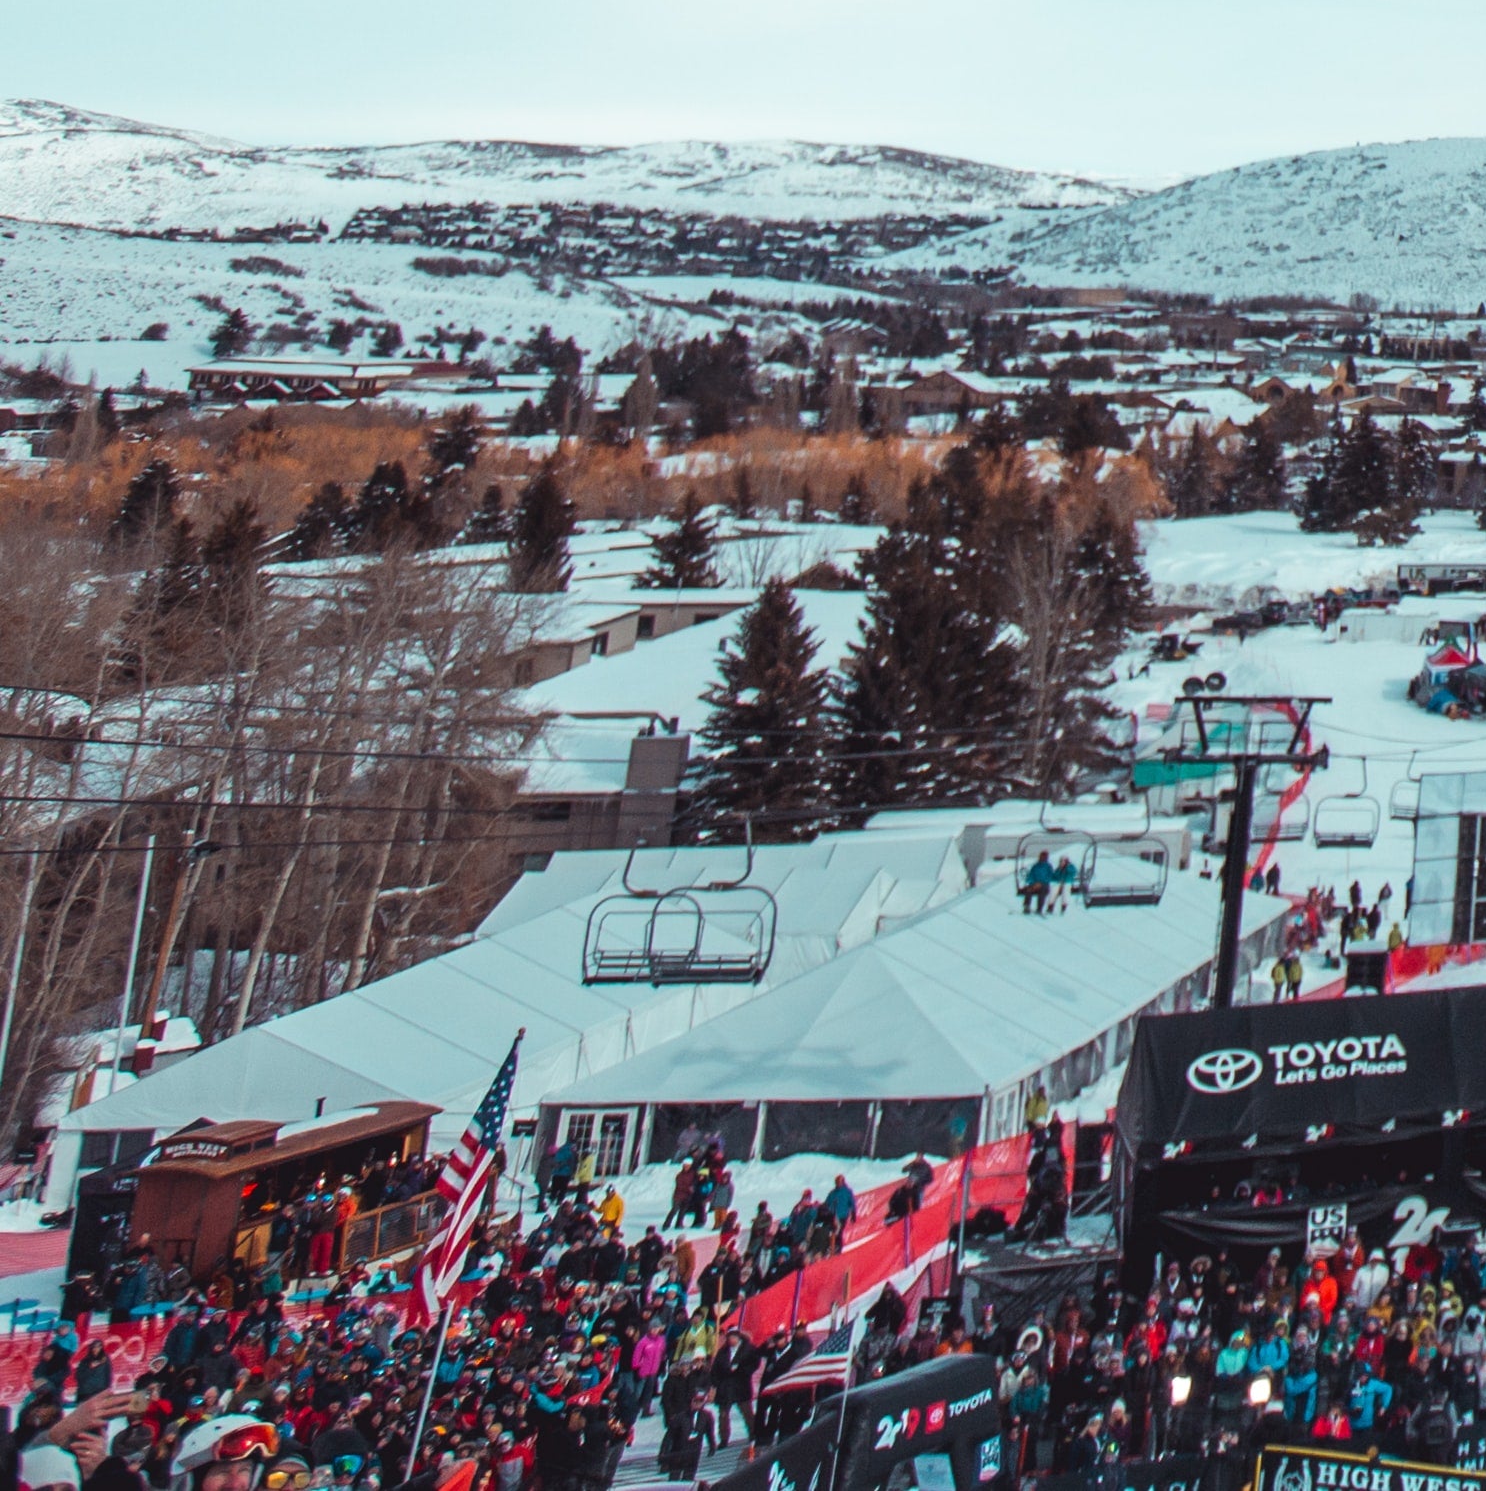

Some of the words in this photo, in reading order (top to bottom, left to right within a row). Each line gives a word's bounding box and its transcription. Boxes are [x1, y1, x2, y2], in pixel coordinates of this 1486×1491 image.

[1268, 1034, 1406, 1068] TOYOTA
[1275, 1067, 1317, 1085] Let's
[1321, 1063, 1347, 1080] Go
[1350, 1060, 1407, 1076] Places
[1311, 1208, 1344, 1226] US
[949, 1388, 992, 1419] TOYOTA
[1316, 1461, 1393, 1490] HIGH
